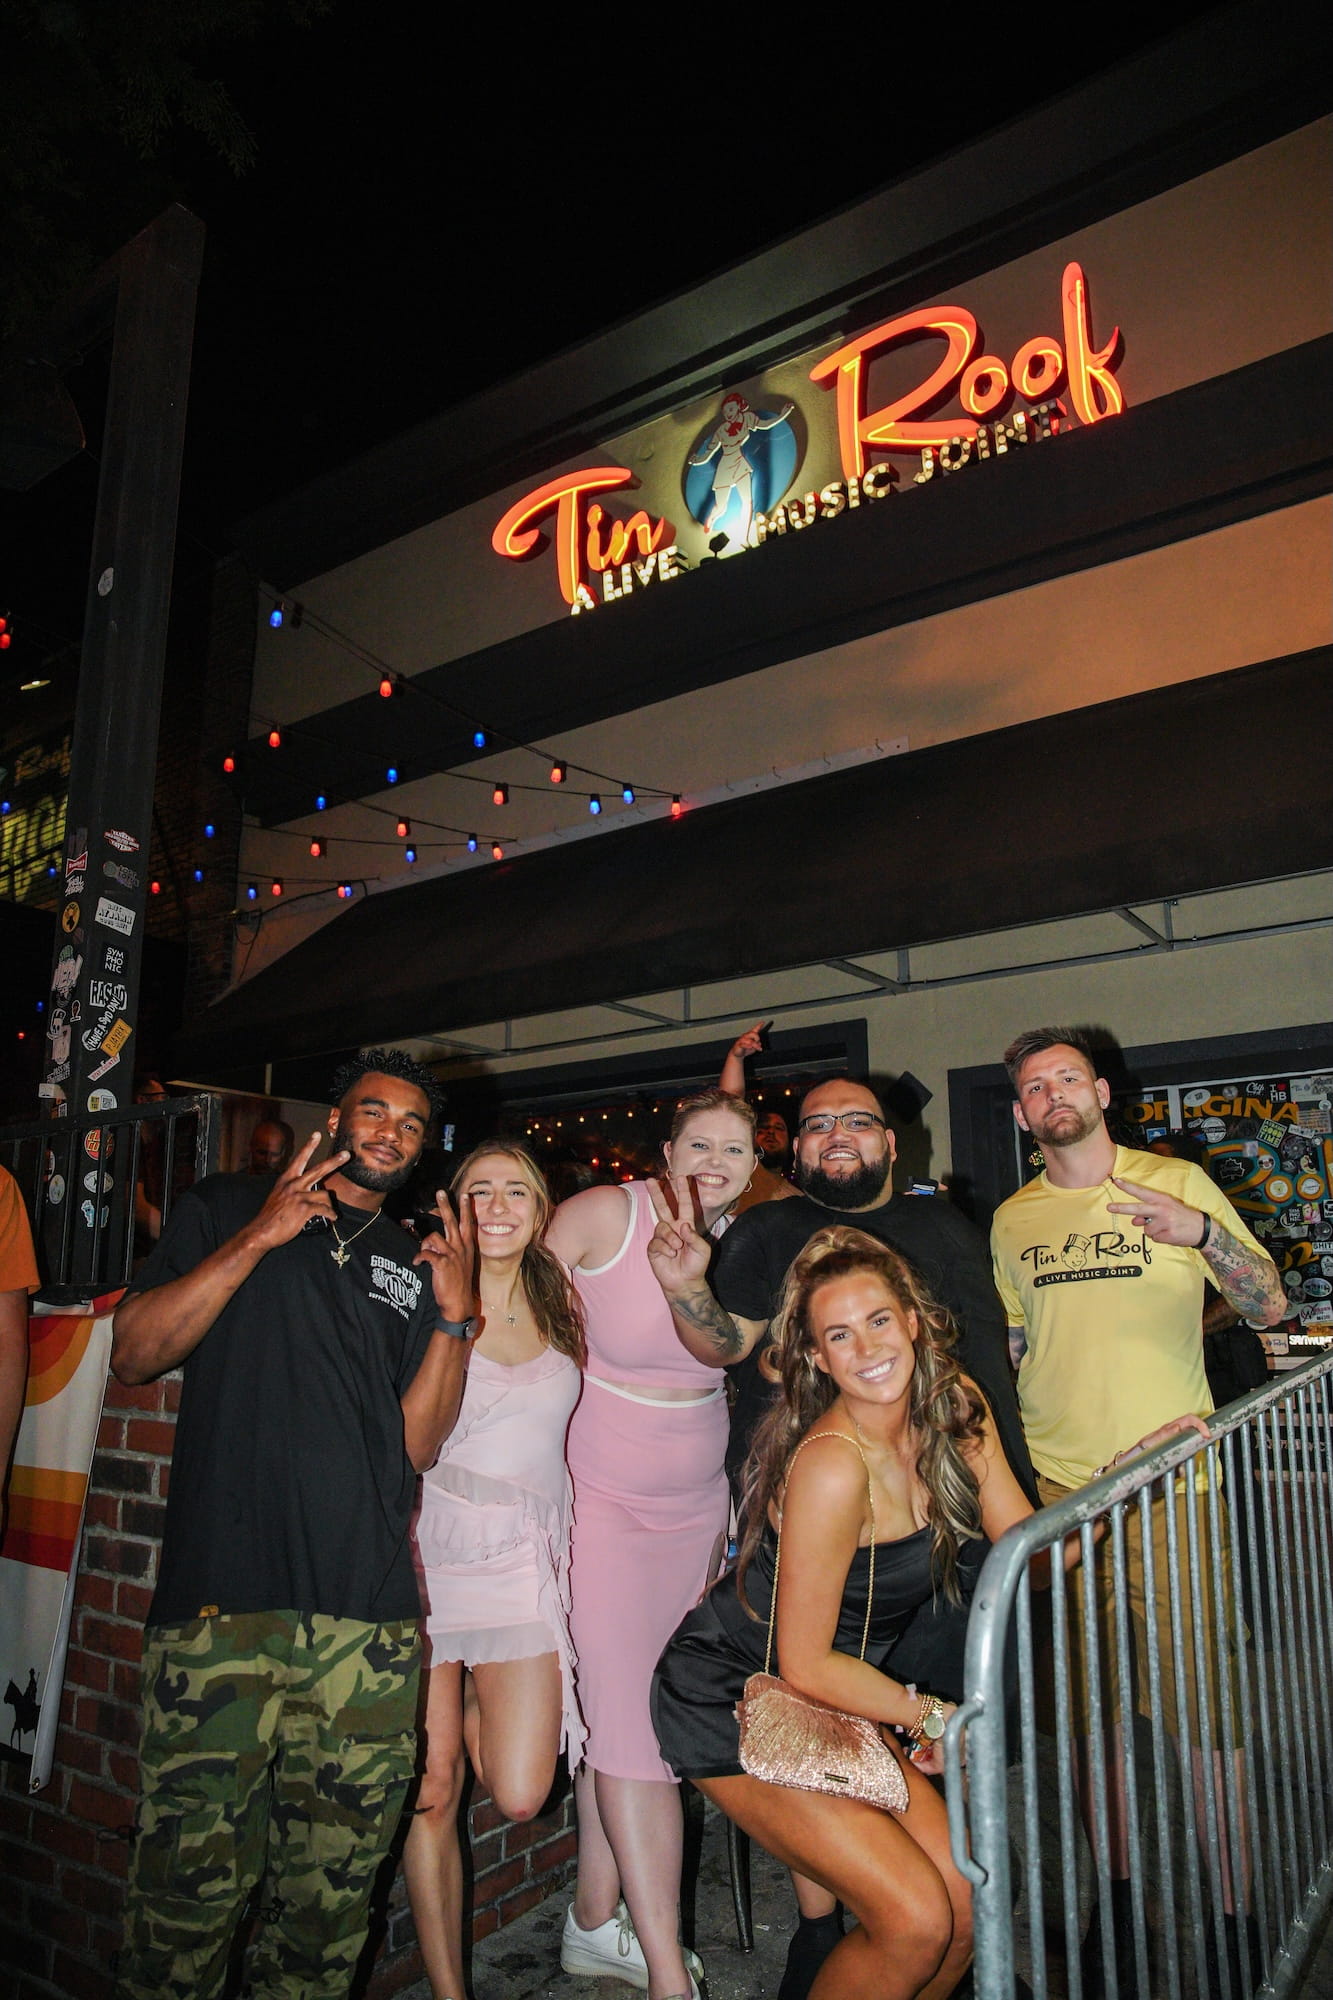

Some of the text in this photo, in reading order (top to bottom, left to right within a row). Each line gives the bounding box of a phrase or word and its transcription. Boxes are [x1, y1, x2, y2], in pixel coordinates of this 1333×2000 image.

[493, 261, 1123, 605] Tin Roof
[571, 398, 1060, 616] A LIVE MUSIC JOINT
[105, 955, 123, 966] PHO
[107, 947, 124, 959] SYM
[104, 962, 122, 974] NIC
[1270, 1092, 1287, 1101] HB
[1126, 1095, 1299, 1124] ORIGINA
[1260, 1132, 1280, 1146] TIME
[1262, 1125, 1283, 1138] GOOD
[1204, 1138, 1333, 1213] Roo
[1020, 1231, 1152, 1271] Tin Roof
[371, 1255, 396, 1274] GOOD
[1046, 1273, 1067, 1284] LIVE
[1071, 1270, 1101, 1280] MUSIC
[1105, 1267, 1136, 1277] JOINT
